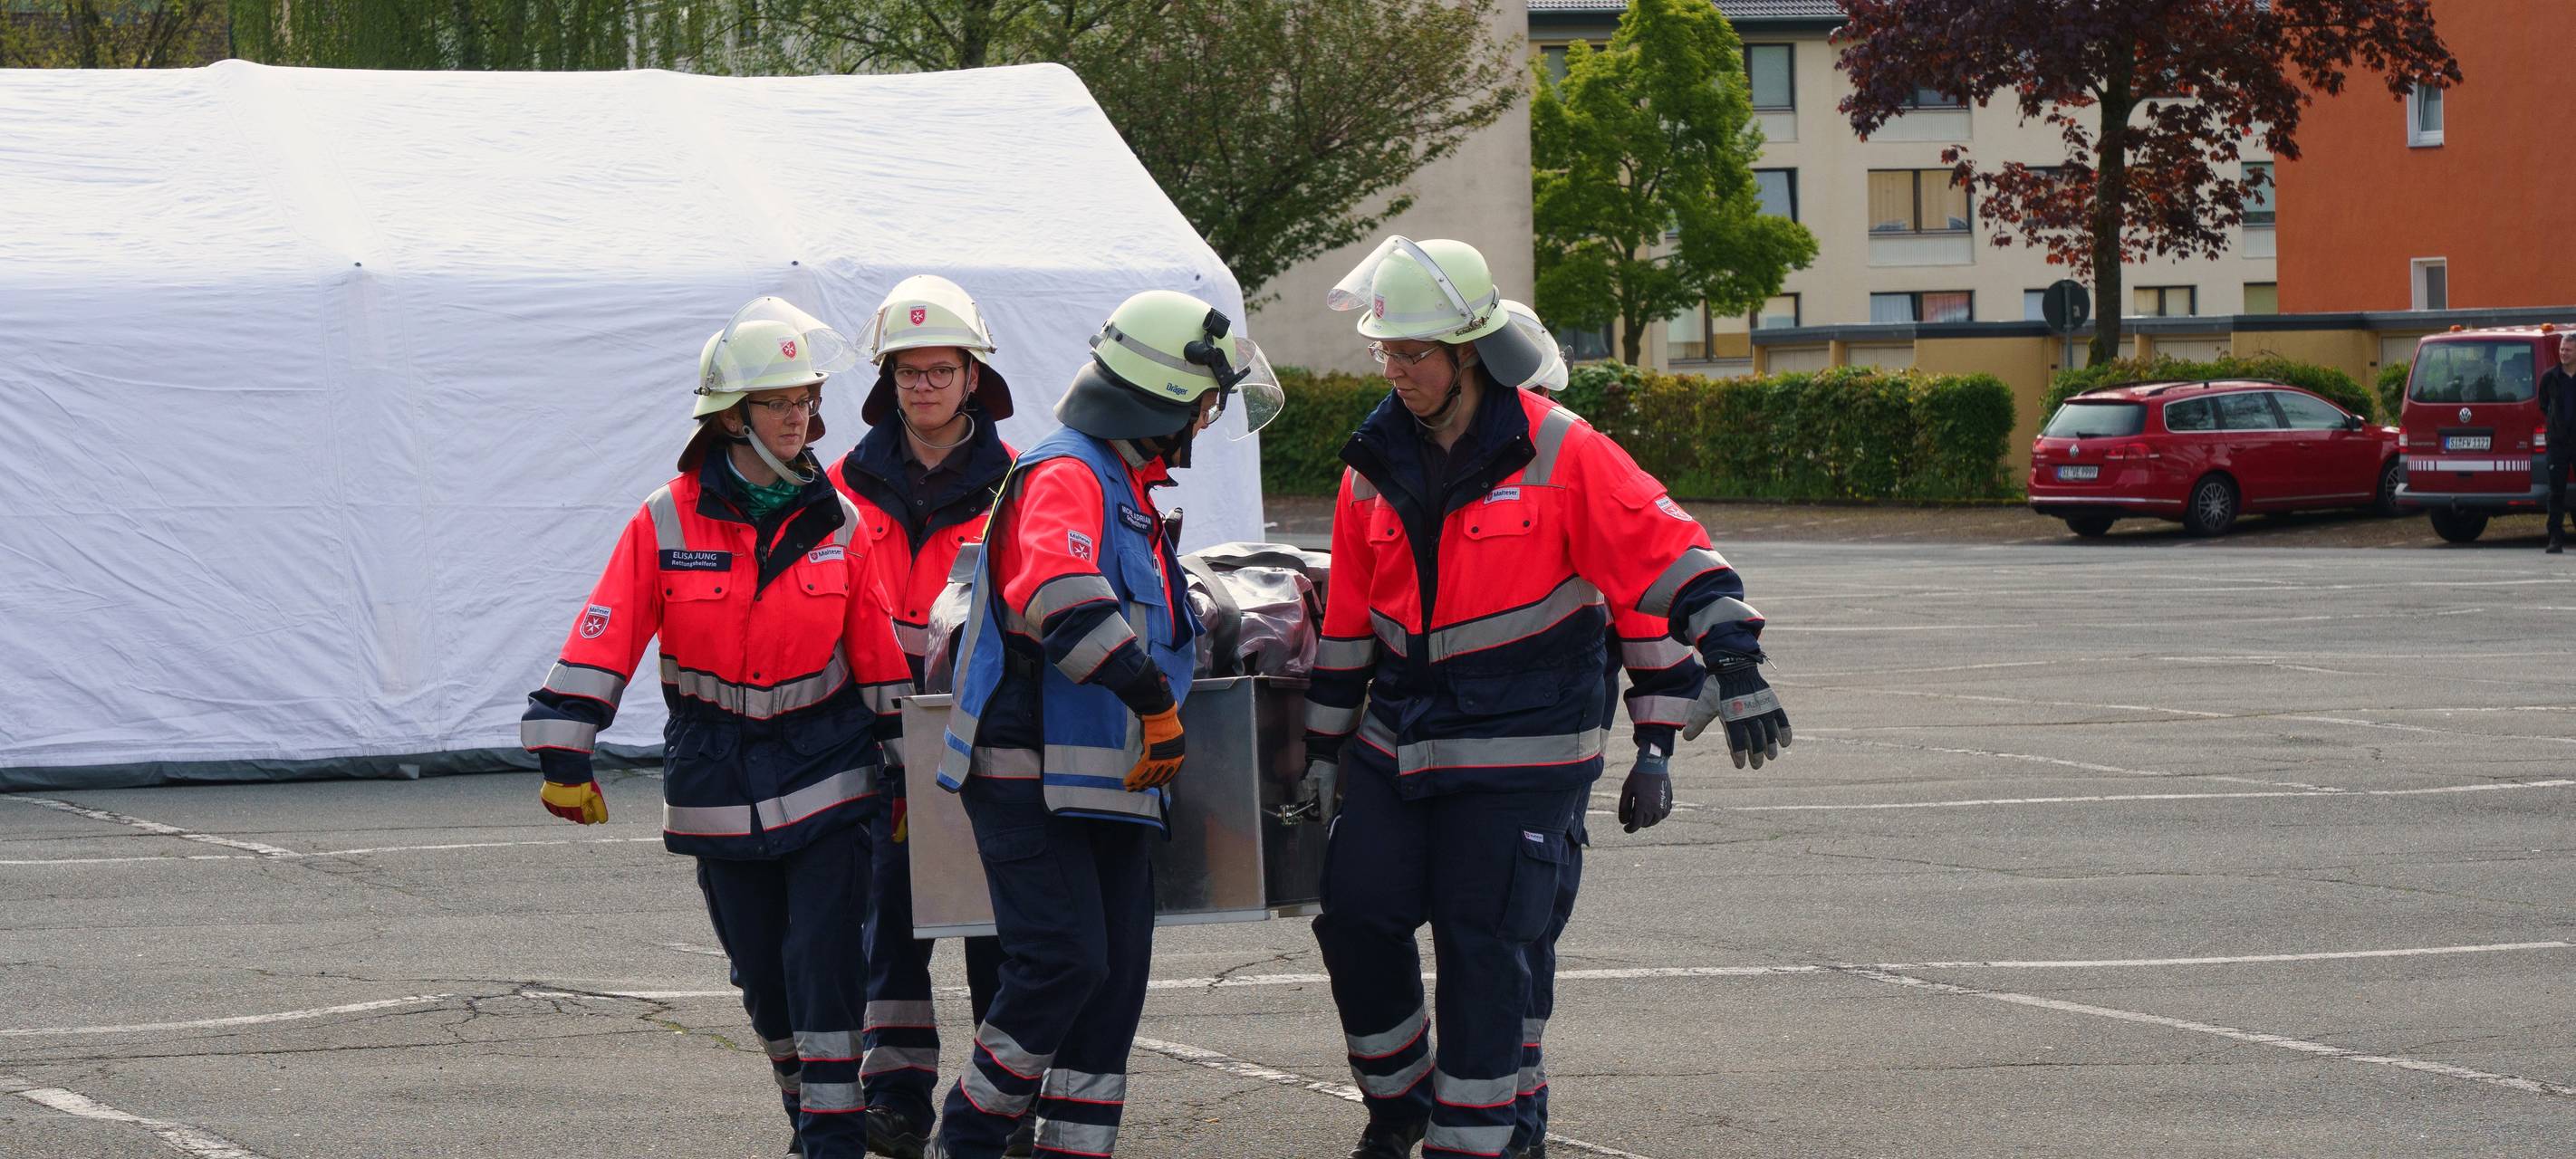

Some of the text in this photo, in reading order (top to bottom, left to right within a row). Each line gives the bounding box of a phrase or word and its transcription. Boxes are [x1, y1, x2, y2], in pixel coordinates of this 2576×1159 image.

[1166, 382, 1187, 395] Dräger
[673, 551, 716, 560] ELISA JUNG
[819, 549, 841, 557] Malteser
[671, 560, 717, 568] Rettungshelferin
[590, 607, 610, 615] Malteser
